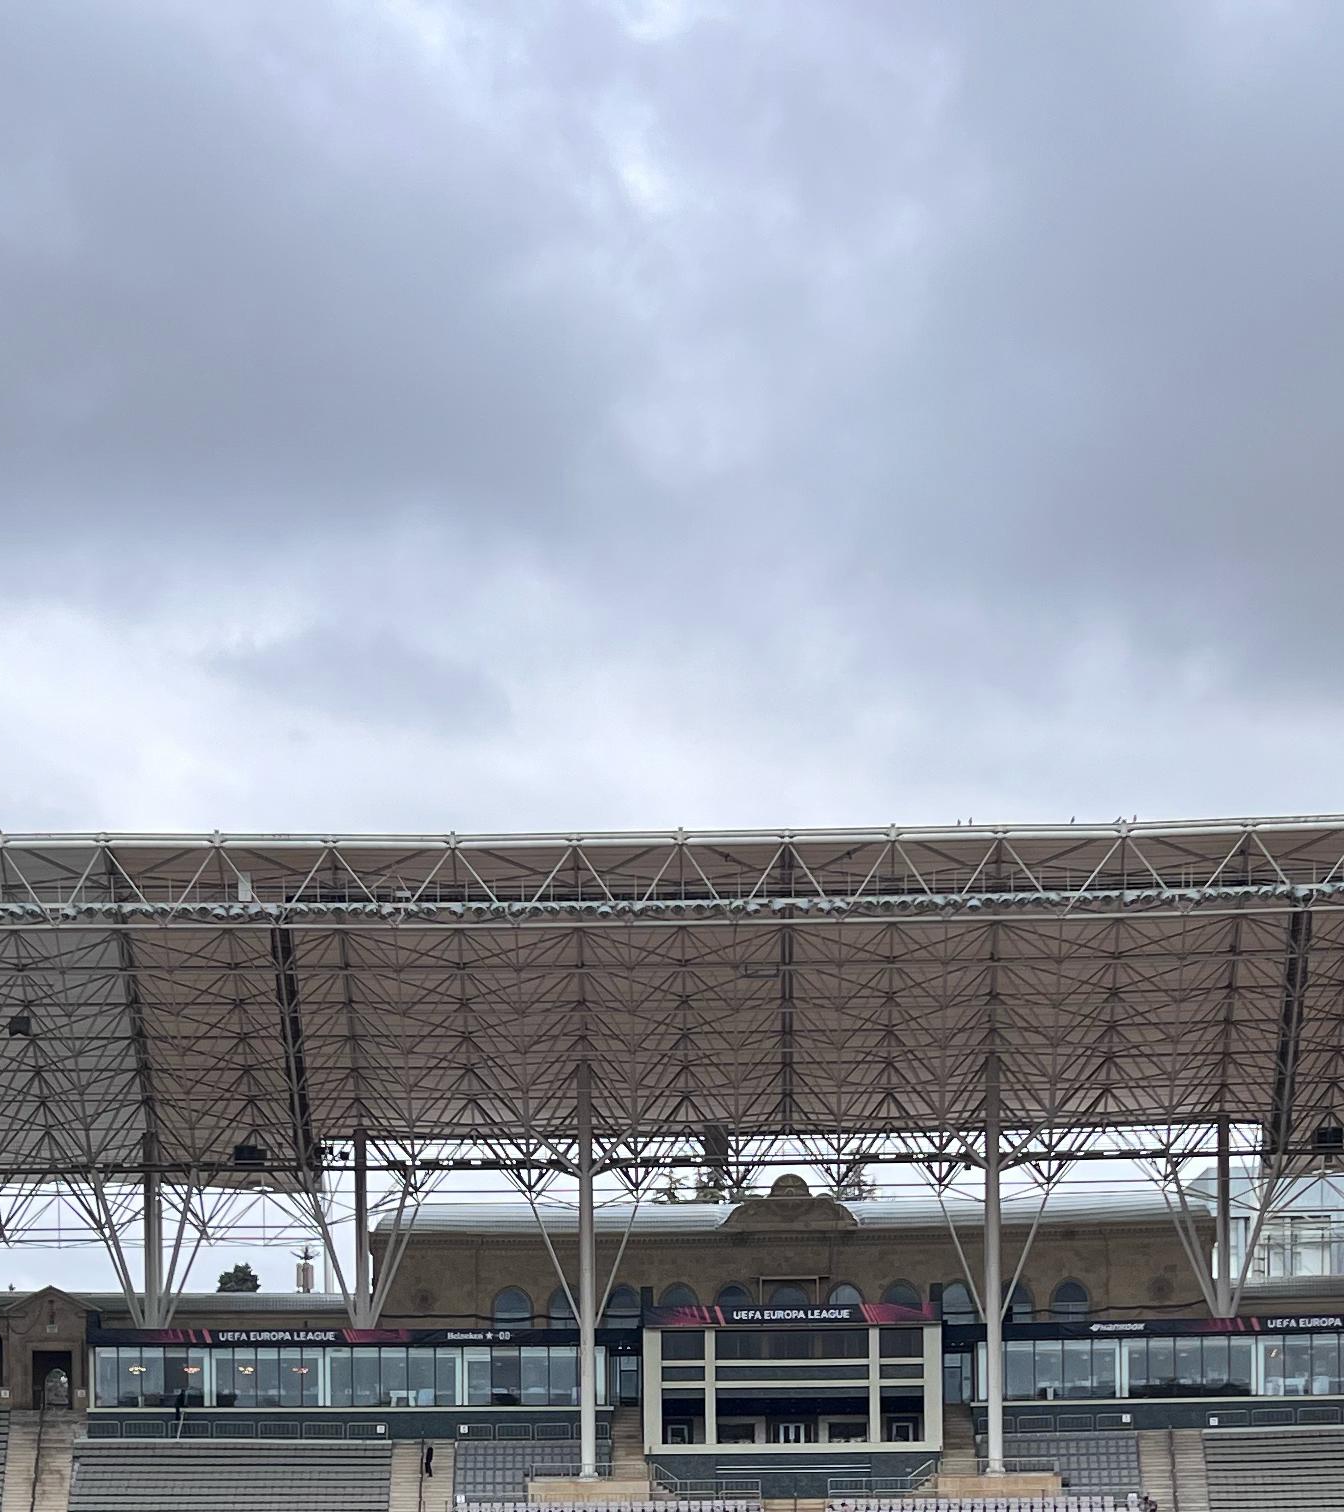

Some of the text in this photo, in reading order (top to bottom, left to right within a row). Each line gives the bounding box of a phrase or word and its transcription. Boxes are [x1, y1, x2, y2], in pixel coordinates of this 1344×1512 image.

[733, 1309, 851, 1320] UEFA EUROPA LEAGUE
[1267, 1319, 1297, 1328] UEFA
[1299, 1317, 1343, 1327] EUROPA
[219, 1331, 336, 1341] UEFA EUROPA LEAGUE
